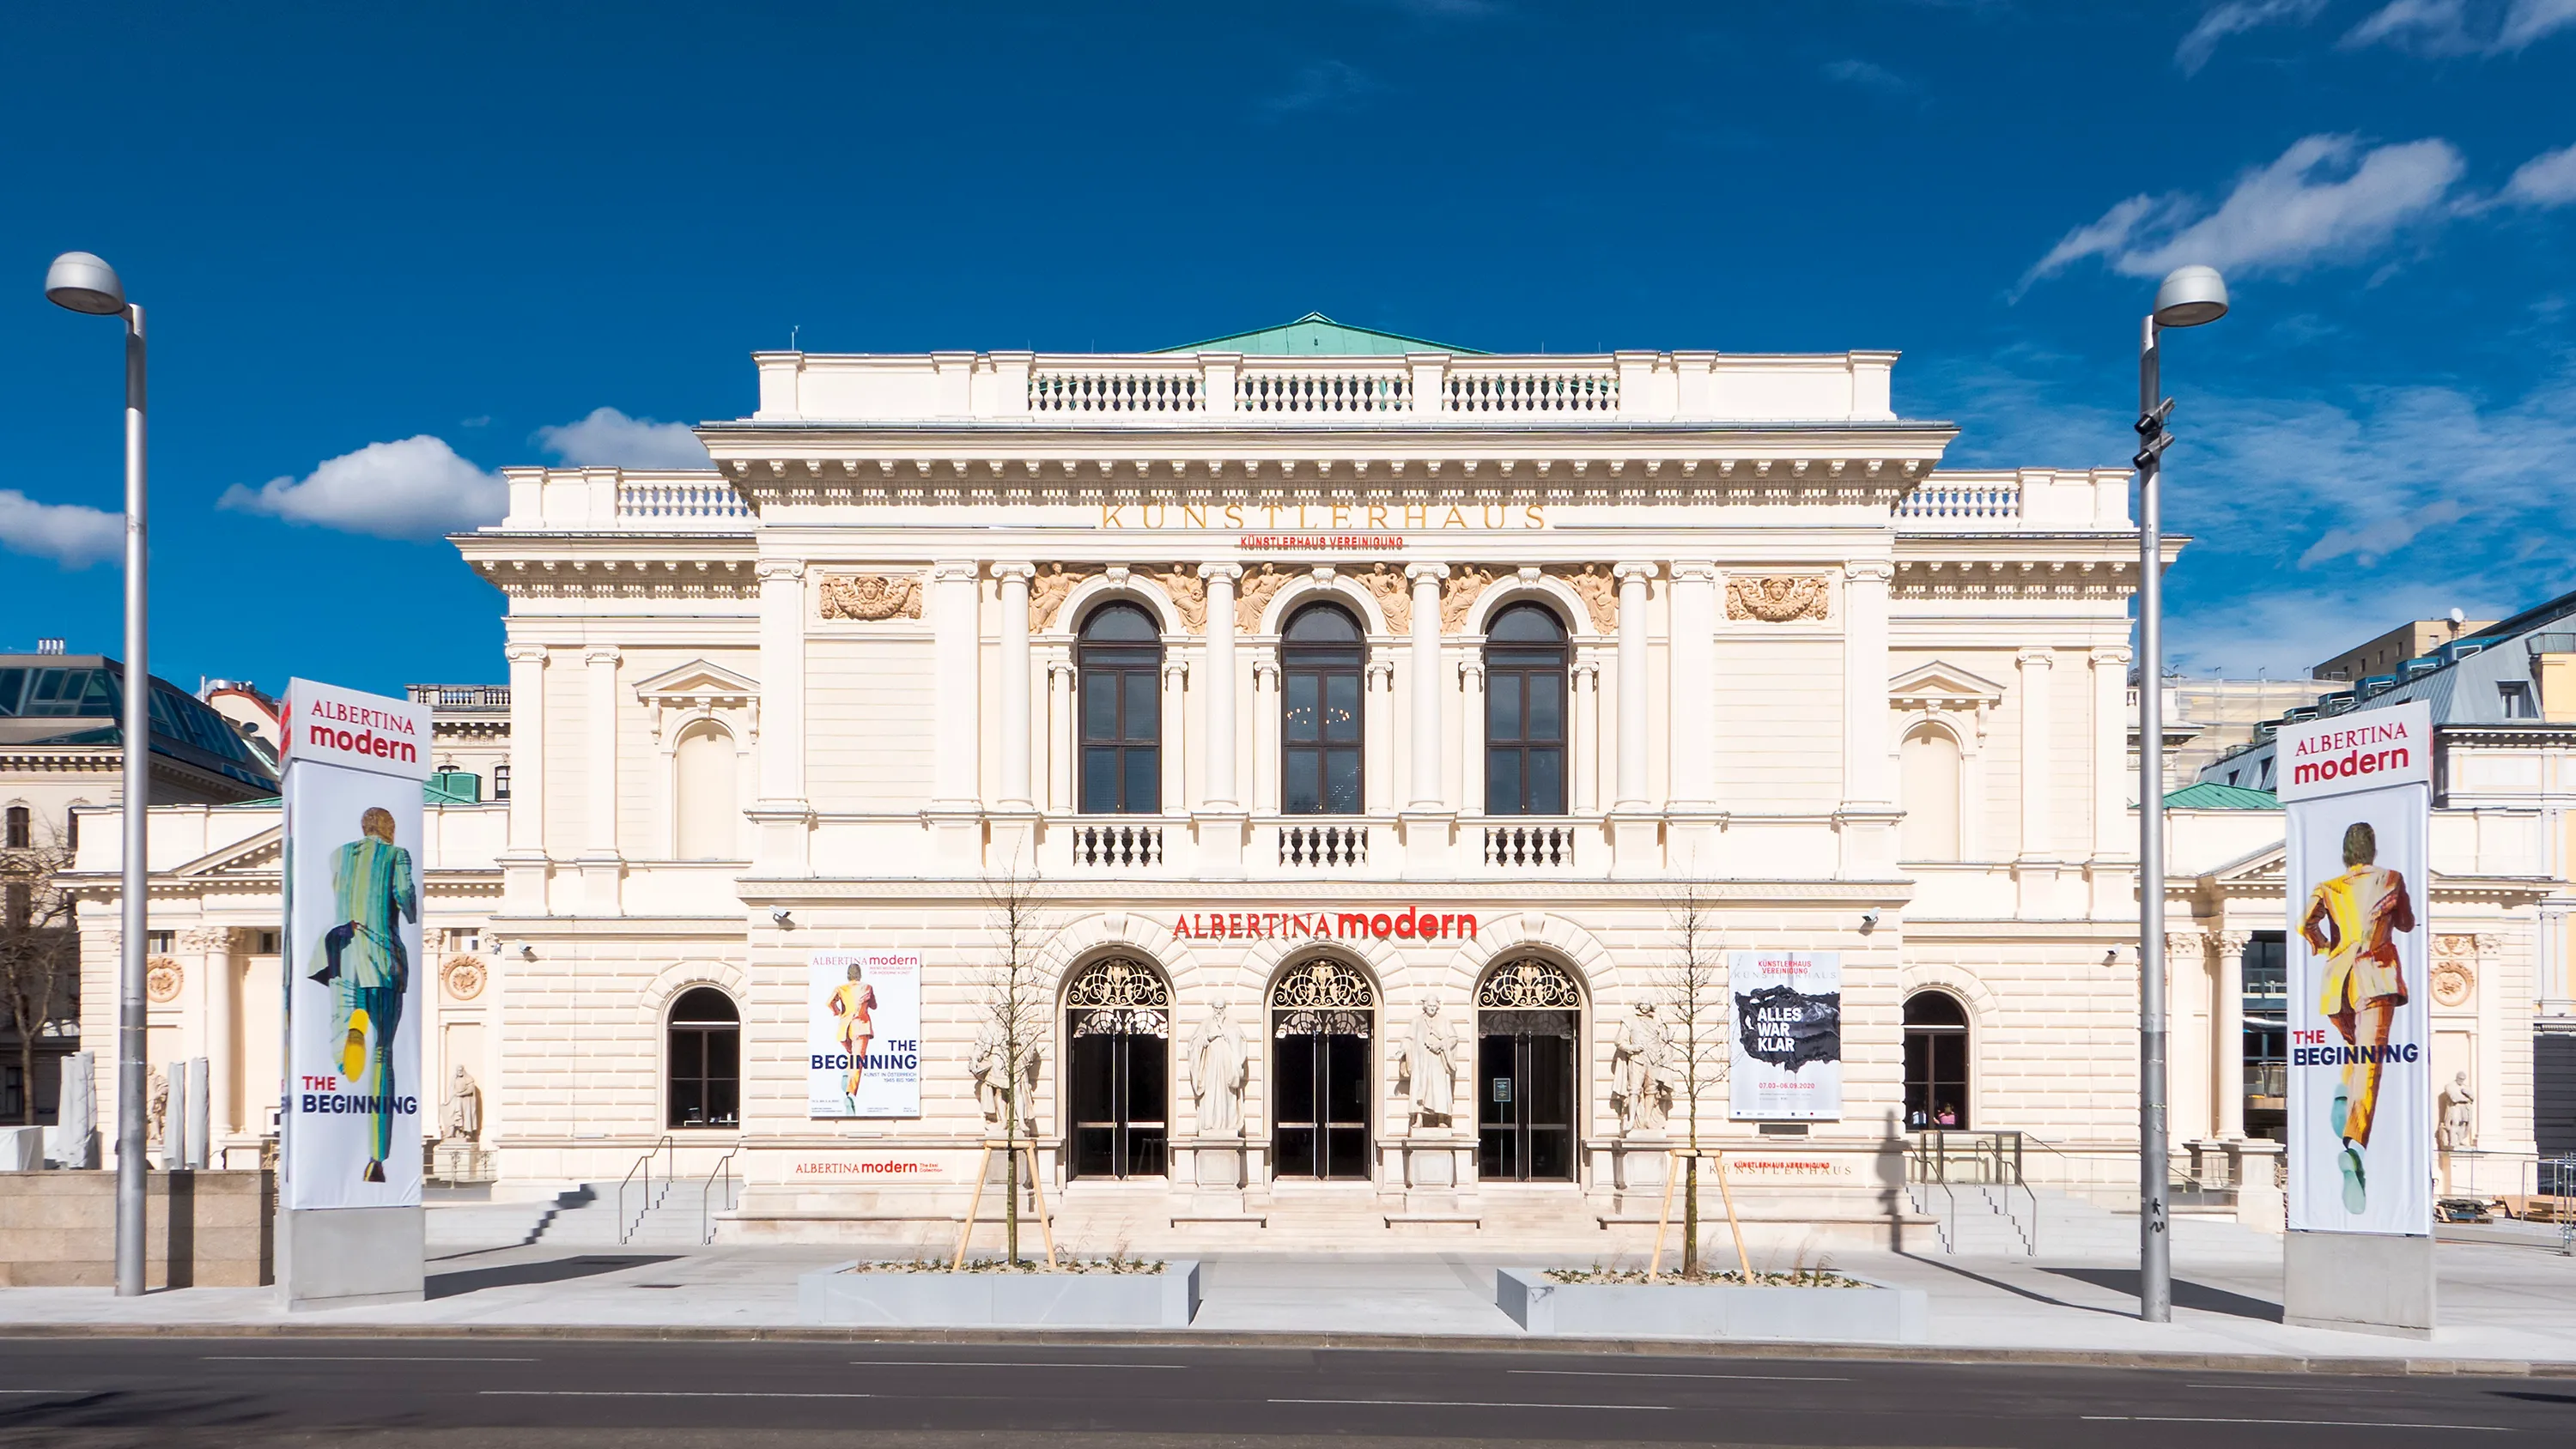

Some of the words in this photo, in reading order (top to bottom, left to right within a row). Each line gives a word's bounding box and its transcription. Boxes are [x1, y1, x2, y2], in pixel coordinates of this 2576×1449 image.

[1103, 500, 1546, 530] KÜNSTLERHAUS
[1241, 534, 1326, 548] KÜNSTLERHAUS
[1329, 536, 1403, 548] VEREINIGUNG
[311, 700, 416, 736] ALBERTINA
[310, 724, 416, 763] modern
[2295, 722, 2409, 756] ALBERTINA
[2295, 748, 2409, 785] modern
[1173, 912, 1332, 941] ALBERTINA
[1337, 906, 1478, 941] modern
[812, 956, 867, 966] ALBERTINA
[869, 955, 918, 966] modern
[1757, 1007, 1802, 1022] ALLES
[1757, 1022, 1790, 1037] WAR
[1758, 1037, 1795, 1052] KLAR
[2293, 1030, 2325, 1045] THE
[888, 1040, 917, 1052] THE
[2293, 1043, 2419, 1065] BEGINNING
[811, 1054, 917, 1070] BEGINNING
[302, 1076, 337, 1091] THE
[302, 1094, 417, 1115] BEGINNING
[796, 1163, 860, 1173] ALBERTINA
[862, 1161, 917, 1173] modern
